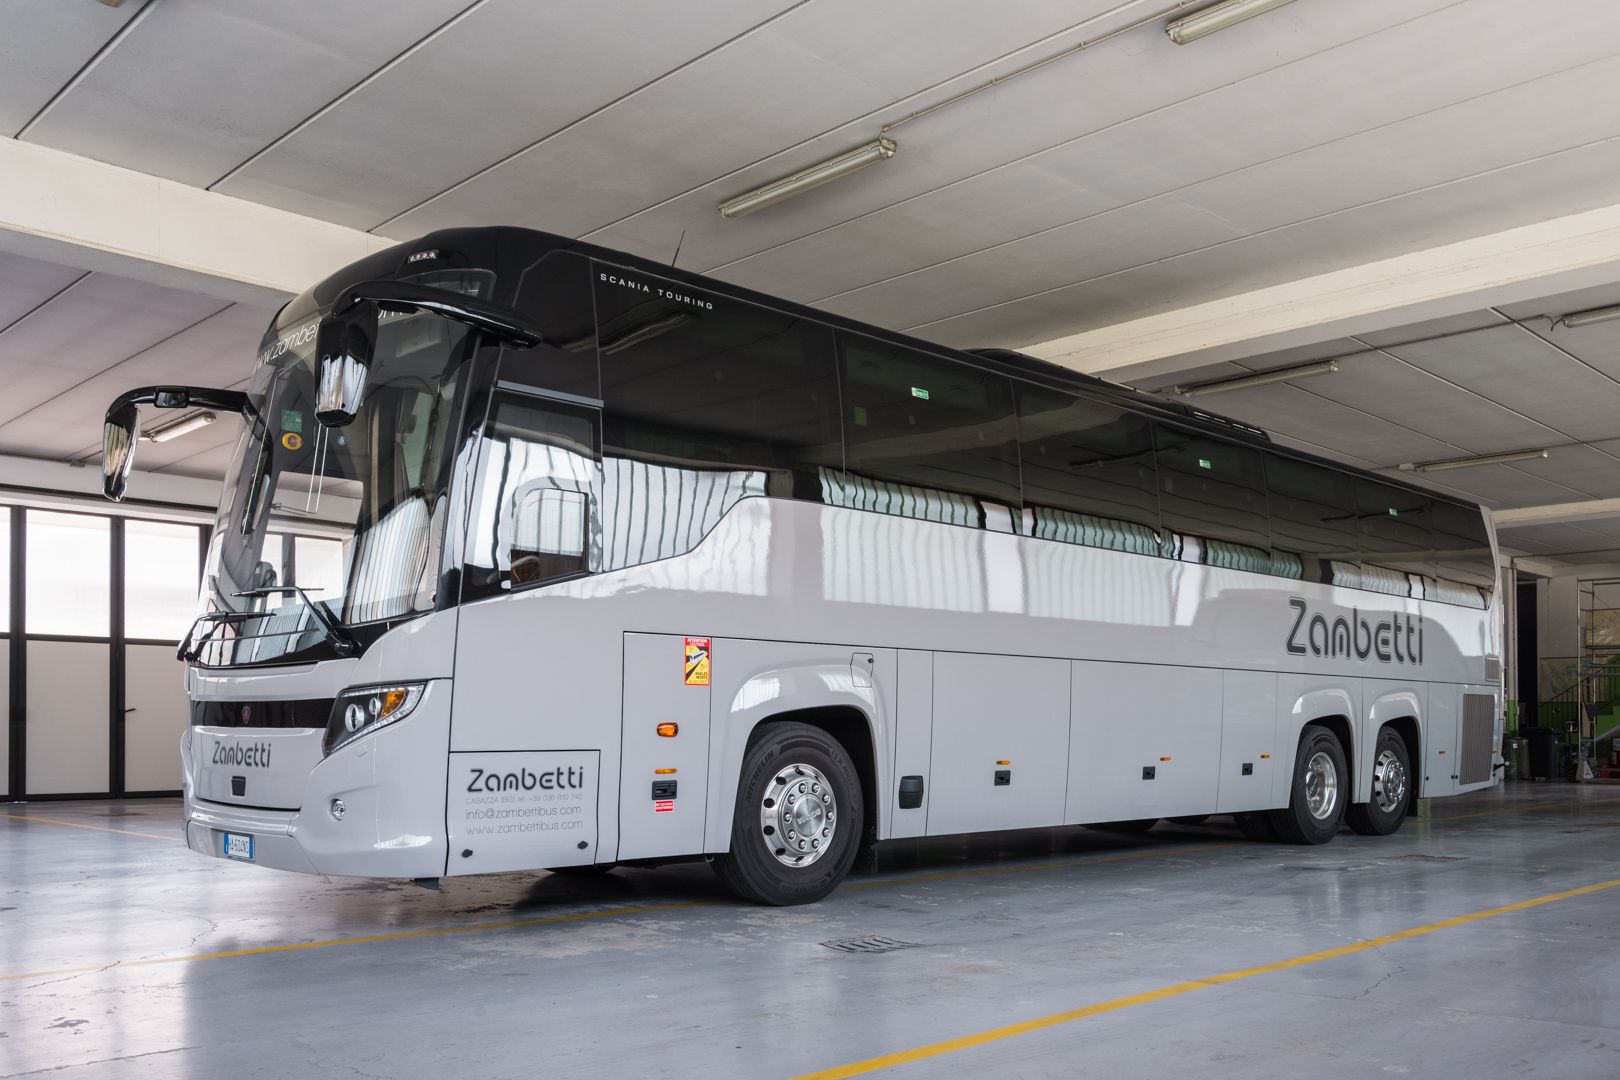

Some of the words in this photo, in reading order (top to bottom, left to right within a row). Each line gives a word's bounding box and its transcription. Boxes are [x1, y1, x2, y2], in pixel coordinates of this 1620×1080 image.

[600, 273, 650, 292] SCANIA
[657, 289, 713, 310] TOURING
[1286, 596, 1423, 666] Zambetti
[212, 740, 272, 768] Zambetti
[467, 766, 583, 793] Zambetti
[465, 806, 581, 820] info@zambettibus.com
[465, 820, 583, 836] www.zambettibus.com
